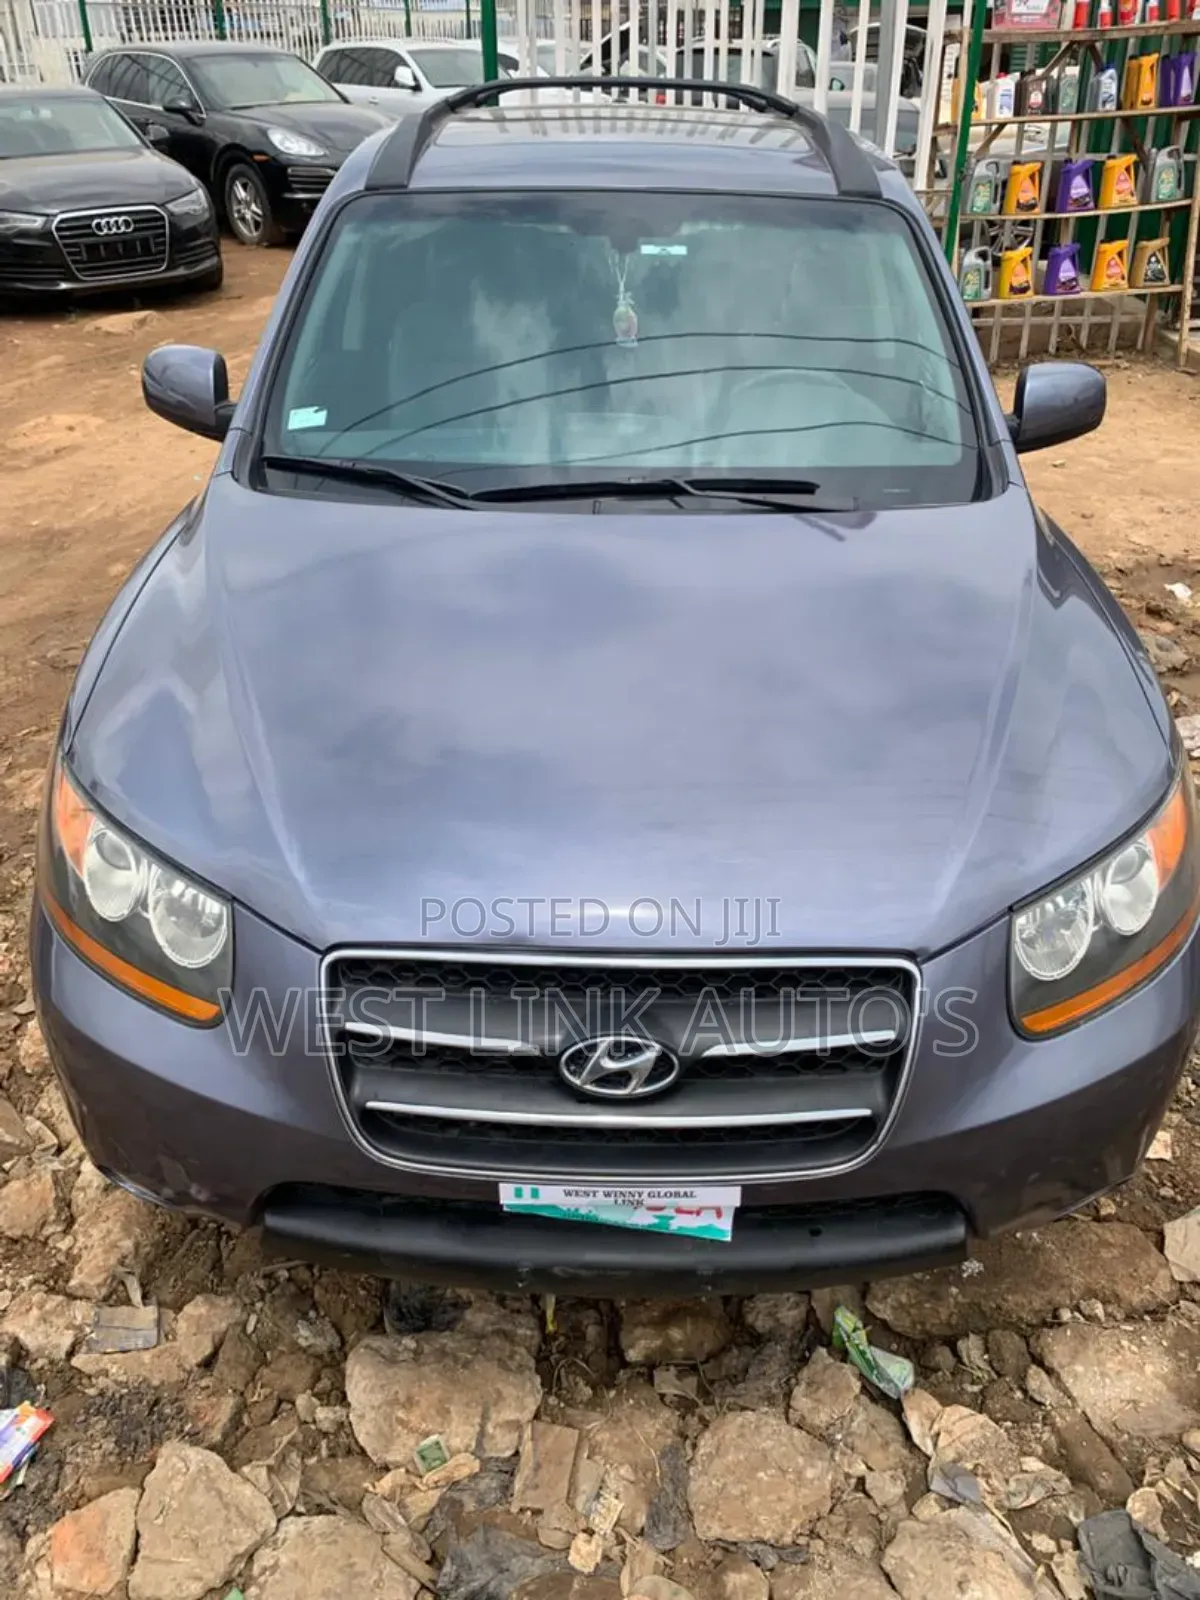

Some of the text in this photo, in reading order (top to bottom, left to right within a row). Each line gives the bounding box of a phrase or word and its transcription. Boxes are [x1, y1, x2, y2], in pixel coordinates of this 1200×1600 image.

[563, 1189, 697, 1199] WEST WINNY GLOBAL
[614, 1199, 644, 1207] LINK
